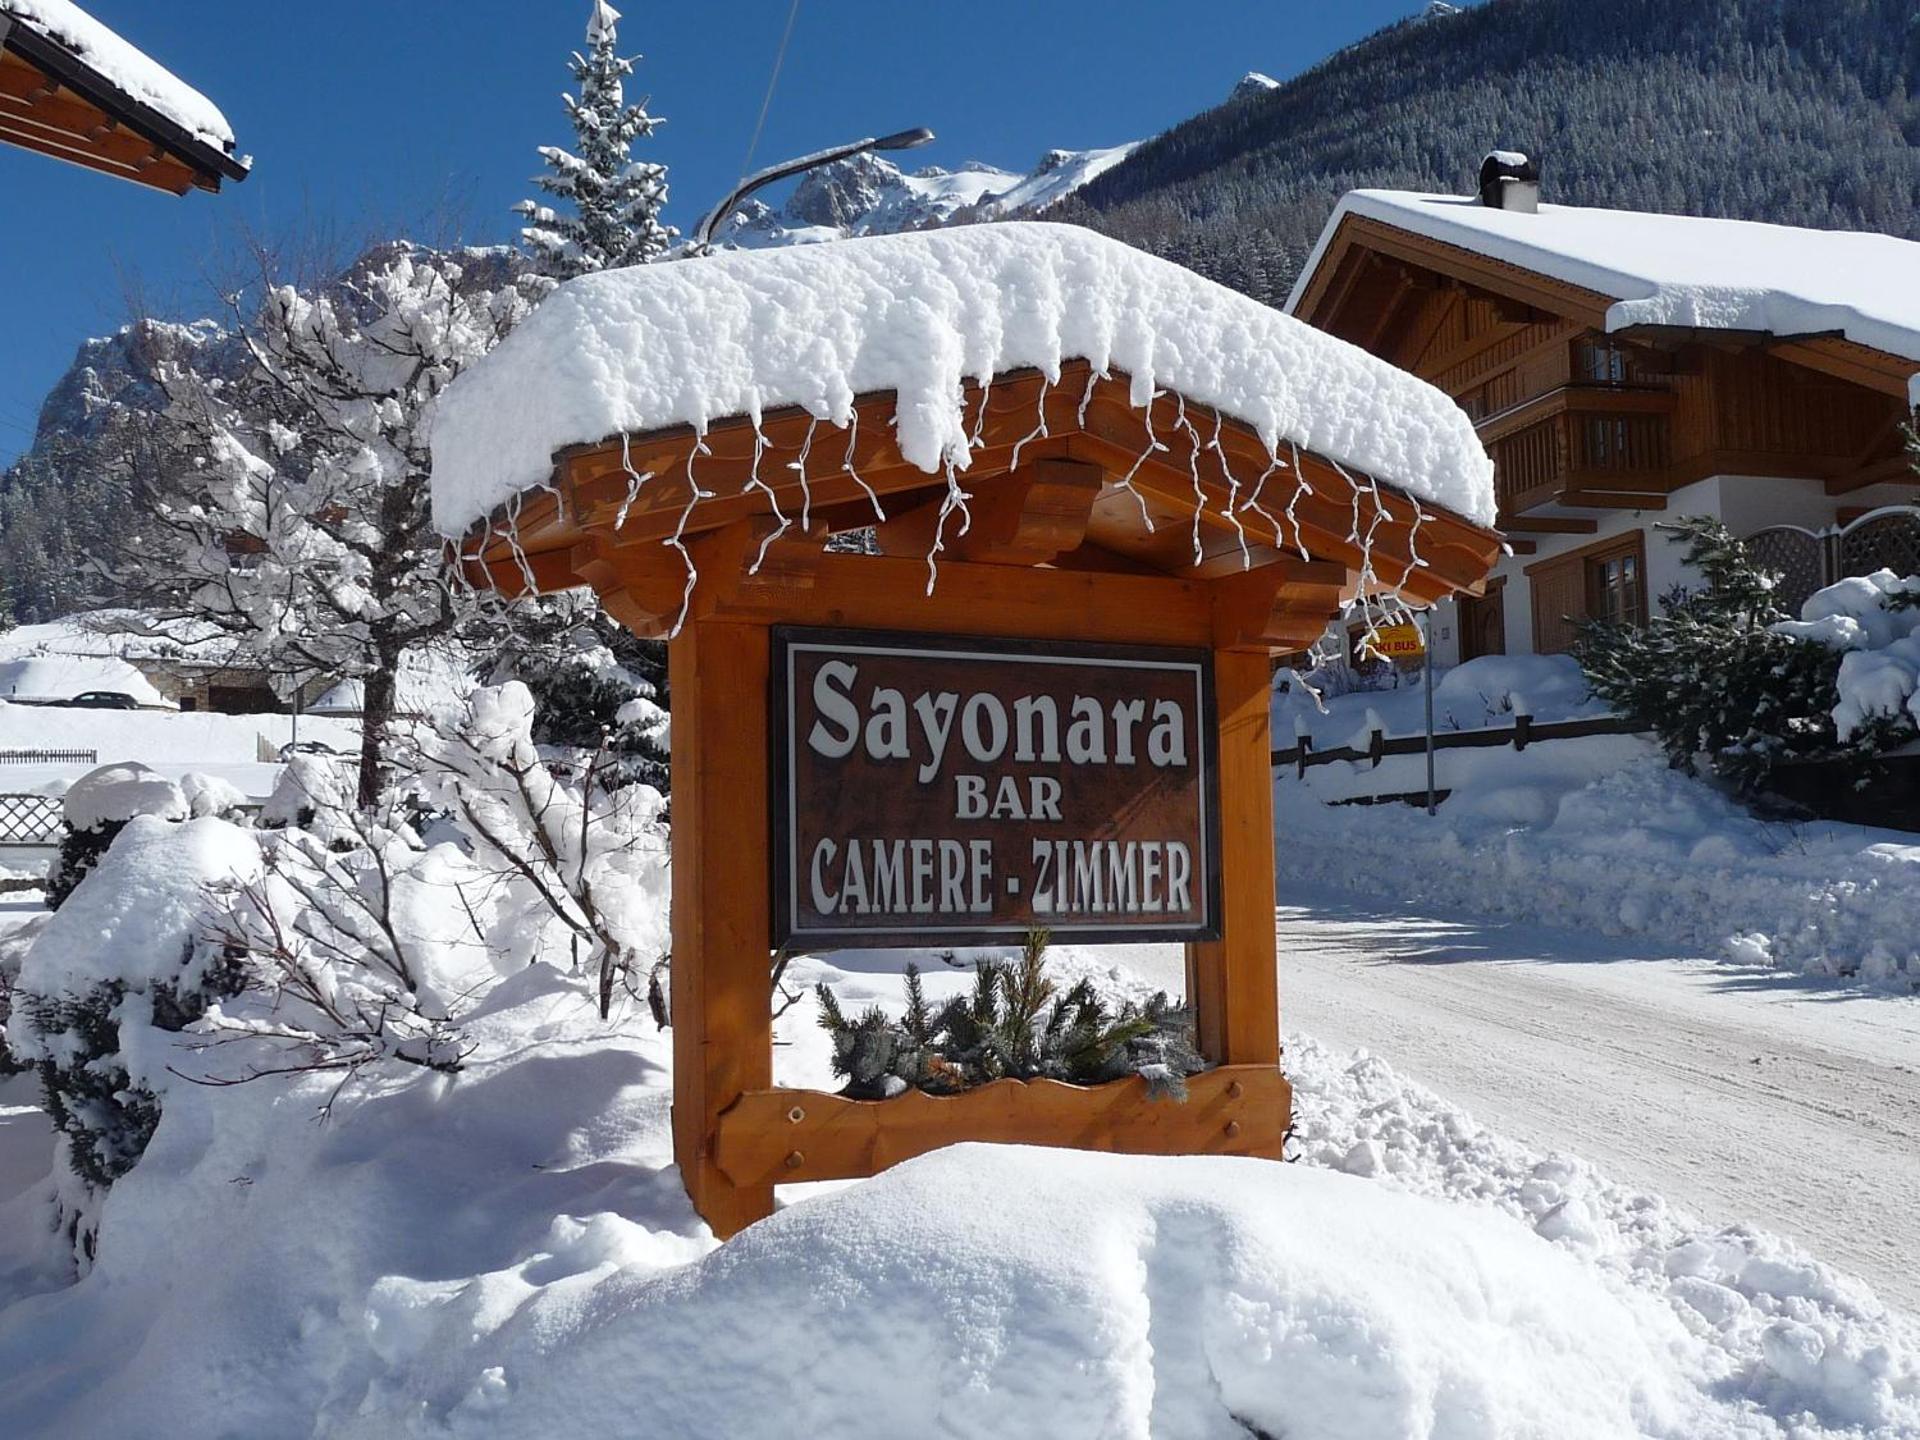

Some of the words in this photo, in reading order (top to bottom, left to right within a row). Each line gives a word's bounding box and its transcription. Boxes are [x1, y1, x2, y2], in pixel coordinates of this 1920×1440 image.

[1394, 640, 1416, 651] BUS
[808, 660, 1187, 783] Sayonara
[956, 776, 1062, 819] BAR
[812, 838, 991, 914] CAMERE
[1032, 838, 1191, 913] ZIMMER
